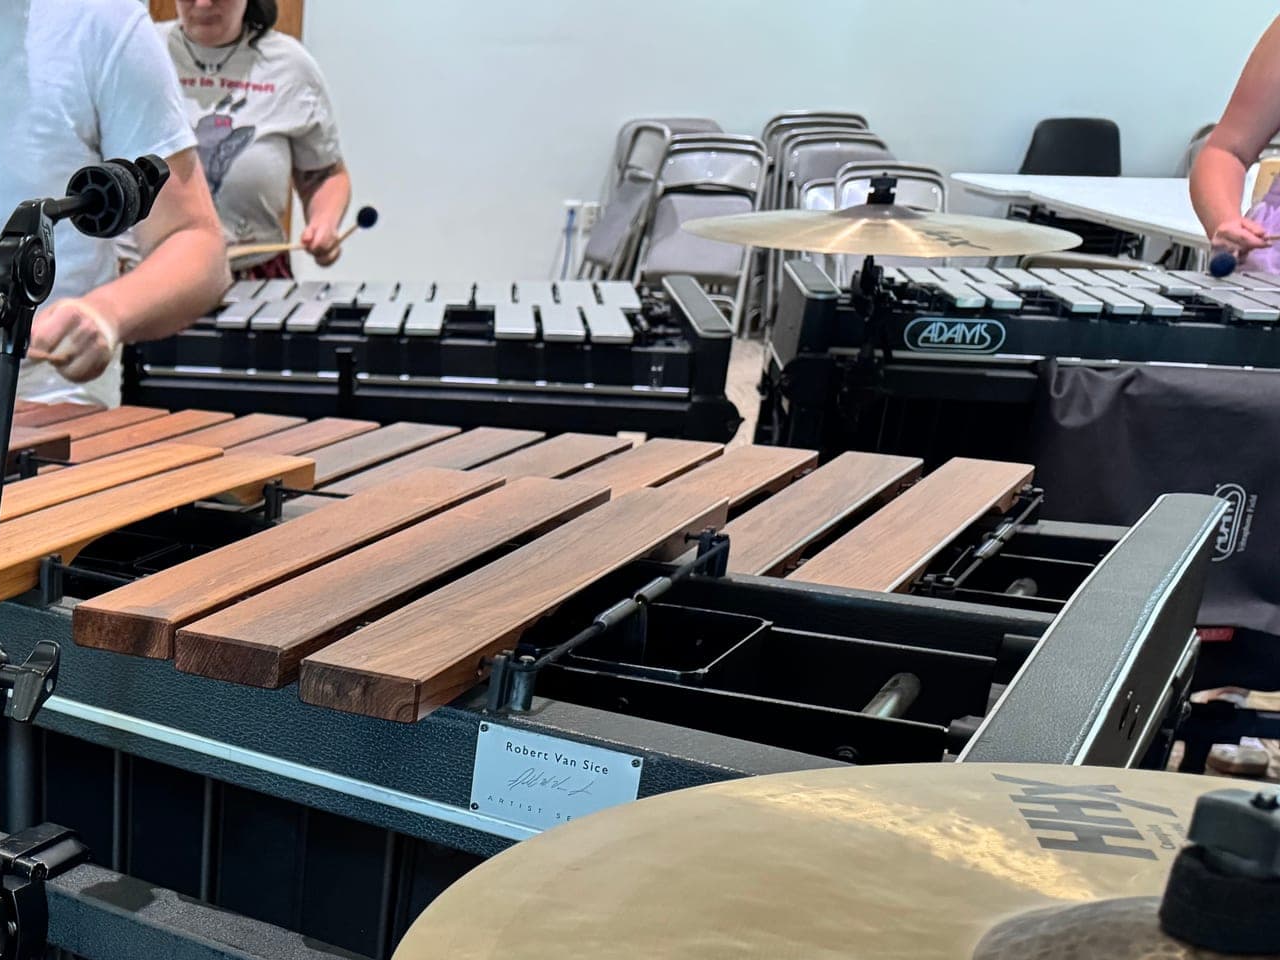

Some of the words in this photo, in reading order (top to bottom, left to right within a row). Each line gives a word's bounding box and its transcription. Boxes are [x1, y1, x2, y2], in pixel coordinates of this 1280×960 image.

[917, 321, 992, 350] ADAMS
[505, 741, 549, 761] Robert
[554, 752, 577, 767] Van
[582, 759, 609, 775] Sice
[487, 794, 542, 814] ARTIST
[991, 772, 1178, 862] HHX
